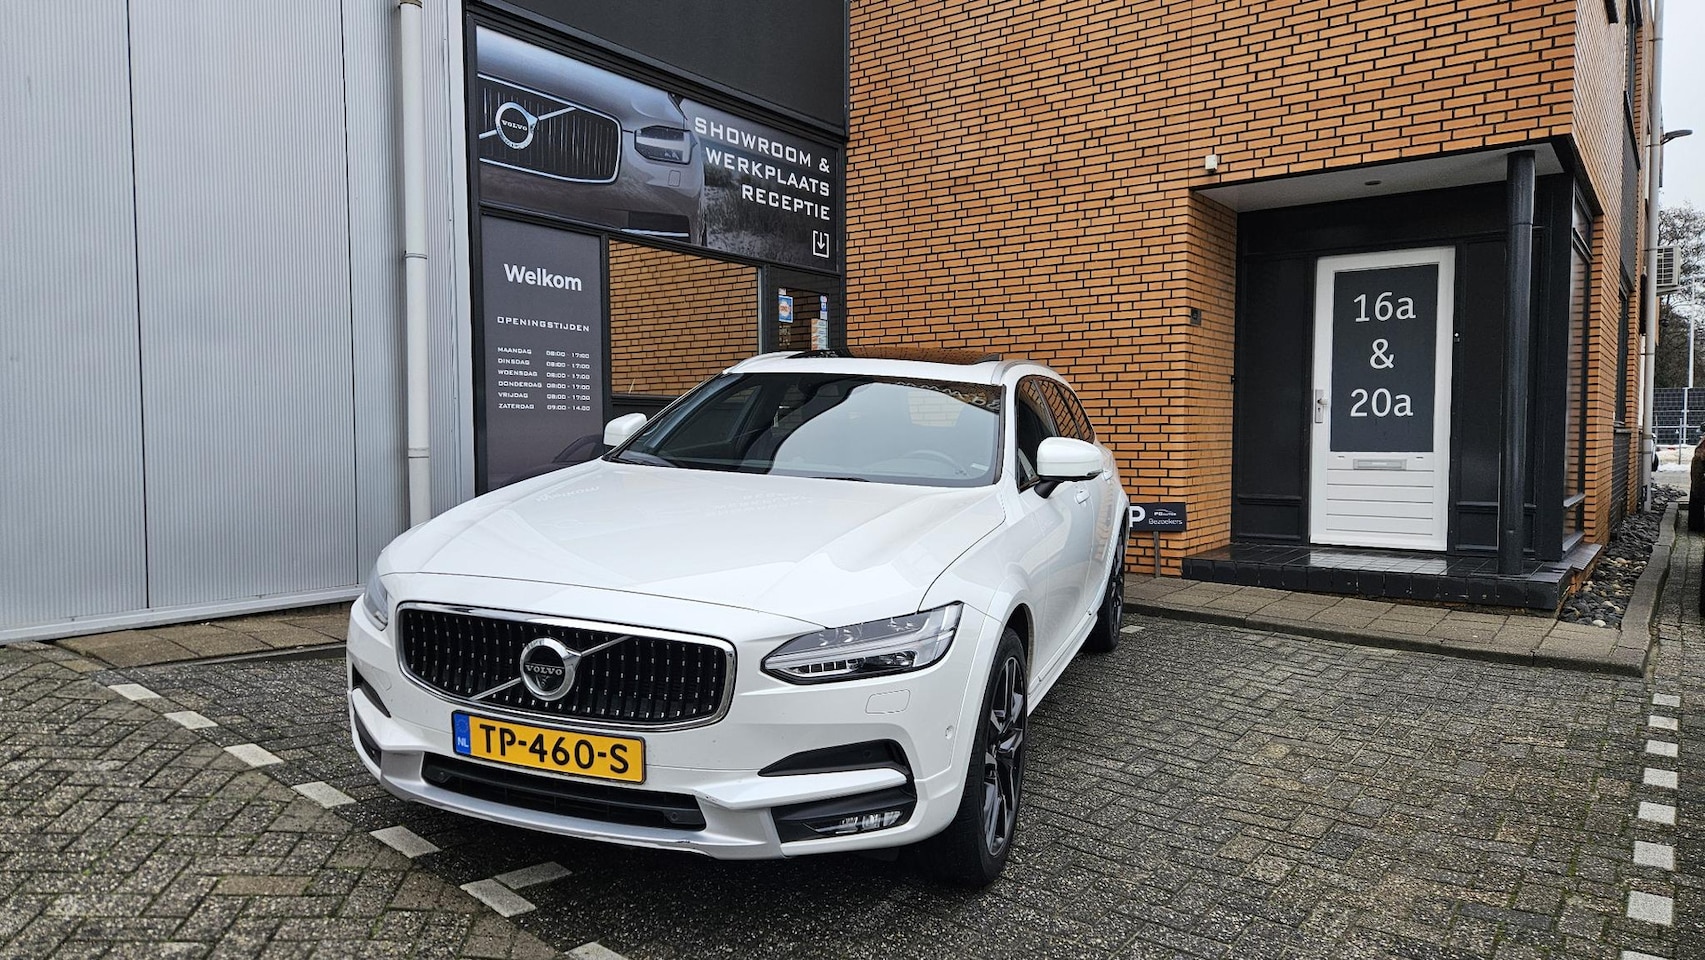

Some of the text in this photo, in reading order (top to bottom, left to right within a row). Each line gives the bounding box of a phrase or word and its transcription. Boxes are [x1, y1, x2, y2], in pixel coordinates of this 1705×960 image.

[500, 119, 528, 131] VOLVO
[694, 116, 831, 174] SHOWROOM &
[705, 146, 830, 197] WERKPLAATS
[741, 183, 831, 221] RECEPTIE
[503, 263, 582, 291] Welkom
[1353, 291, 1417, 323] 16a
[497, 316, 590, 332] OPENINGSTIJDEN
[497, 346, 532, 355] MAANDAG
[1369, 338, 1395, 370] &
[497, 358, 530, 366] DINSDAG
[497, 369, 538, 377] WOENSDAG
[498, 380, 543, 389] DONDERDAG
[497, 391, 529, 399] VRIJDAG
[1350, 388, 1413, 418] 20a
[1129, 505, 1146, 528] P
[525, 664, 563, 676] VOLVO
[457, 736, 469, 748] NL
[479, 723, 629, 774] TP-460-S
